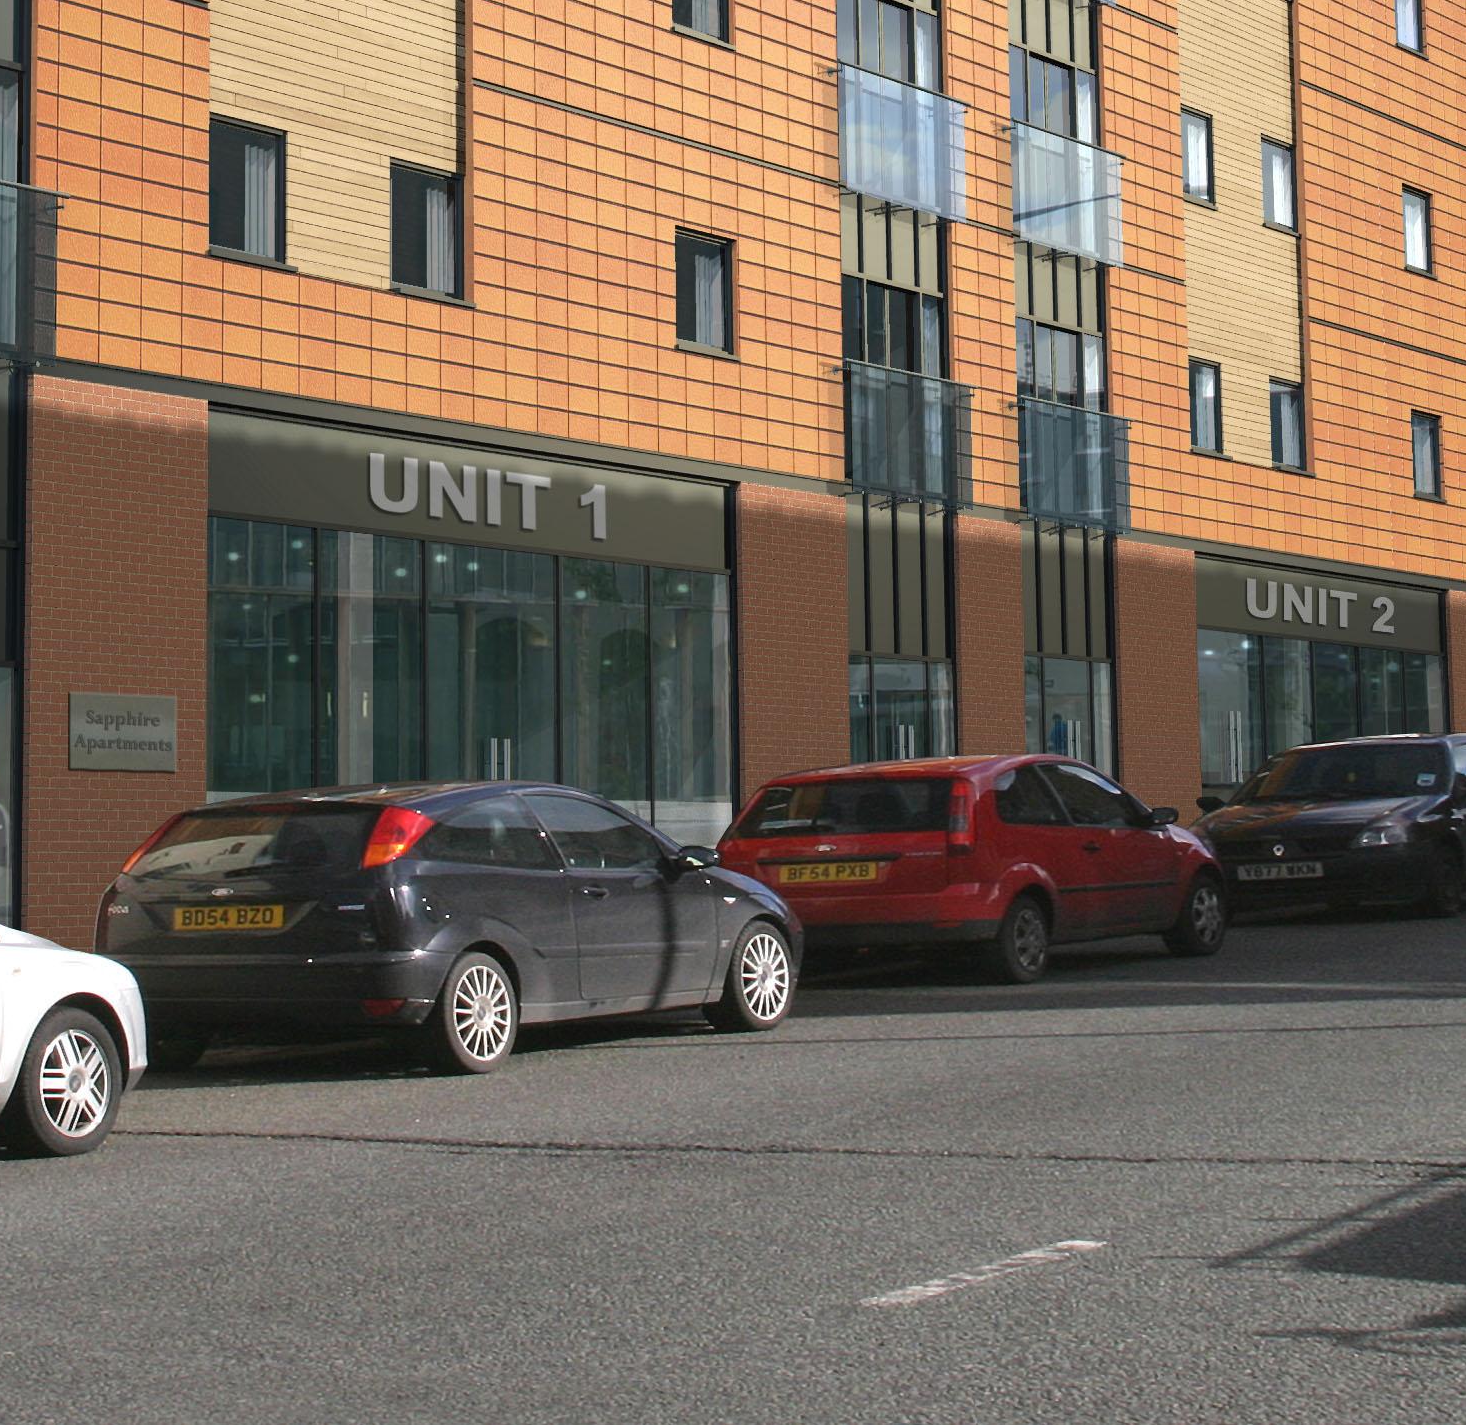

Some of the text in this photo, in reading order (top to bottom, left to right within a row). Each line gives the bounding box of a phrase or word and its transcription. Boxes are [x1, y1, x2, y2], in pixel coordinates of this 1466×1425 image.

[366, 451, 609, 541] UNIT 1
[1244, 577, 1396, 634] UNIT 2
[85, 709, 161, 731] Sapphire
[73, 733, 173, 755] Apartments
[786, 863, 870, 882] BF54 PXB
[181, 909, 231, 927] BD54
